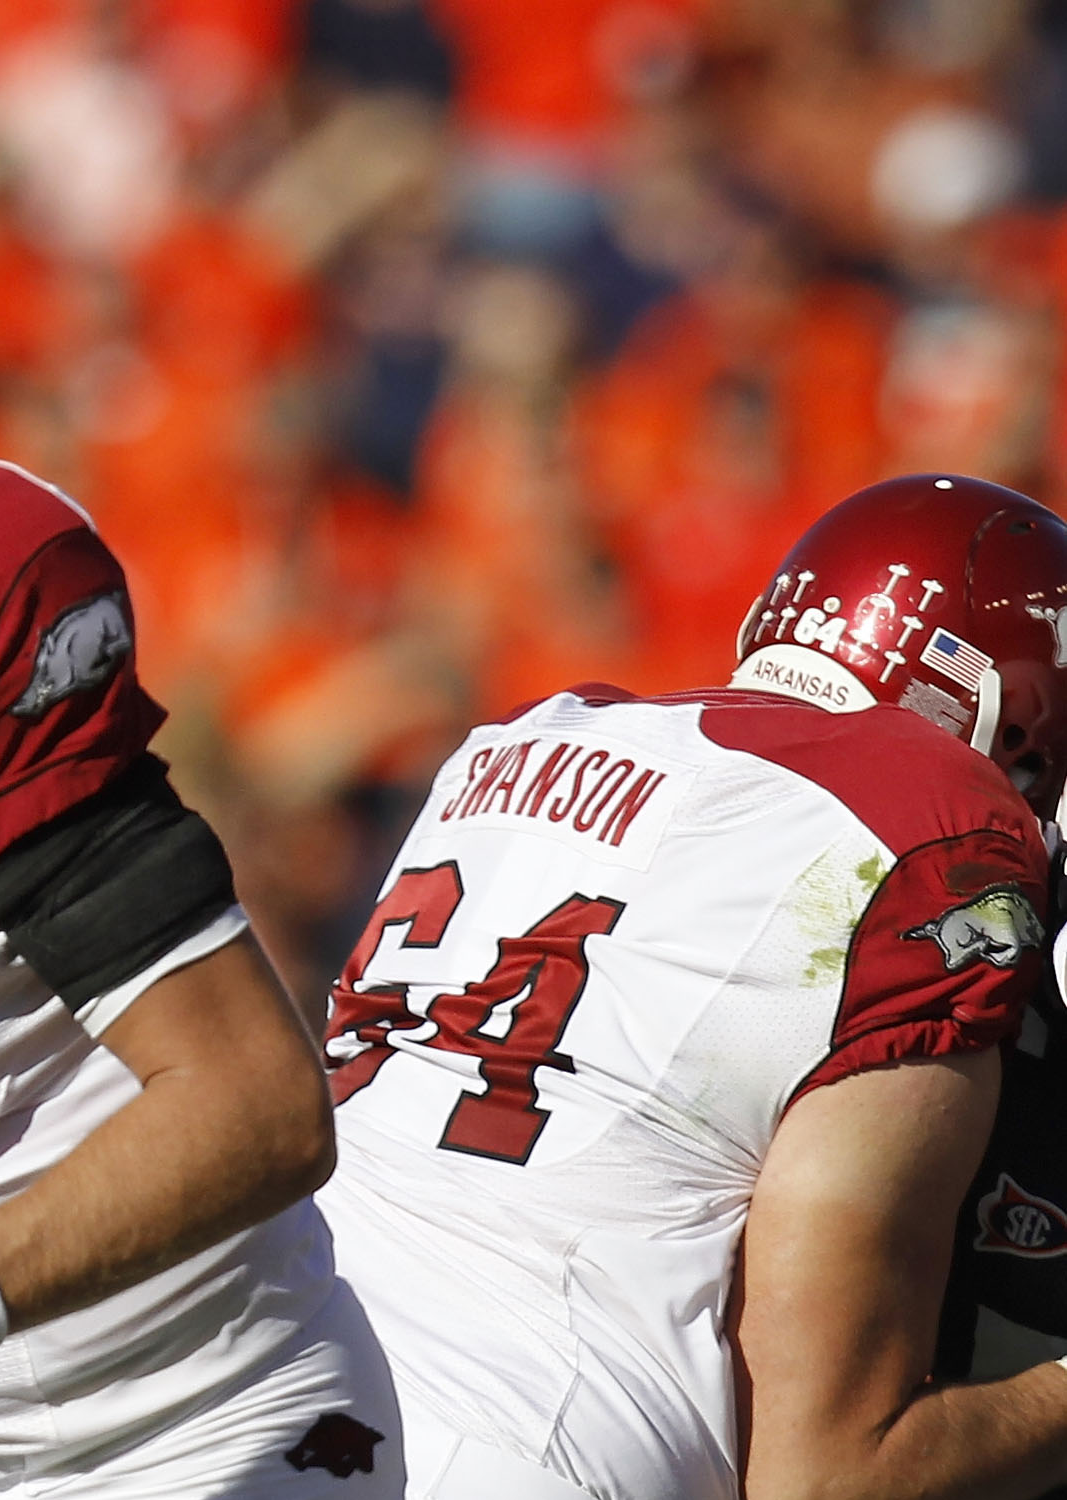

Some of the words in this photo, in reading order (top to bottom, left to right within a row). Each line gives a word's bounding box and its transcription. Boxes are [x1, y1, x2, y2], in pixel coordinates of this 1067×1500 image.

[793, 608, 848, 654] 64
[754, 658, 850, 706] ARKANSAS
[440, 738, 668, 848] SWANSON
[325, 860, 627, 1167] 64
